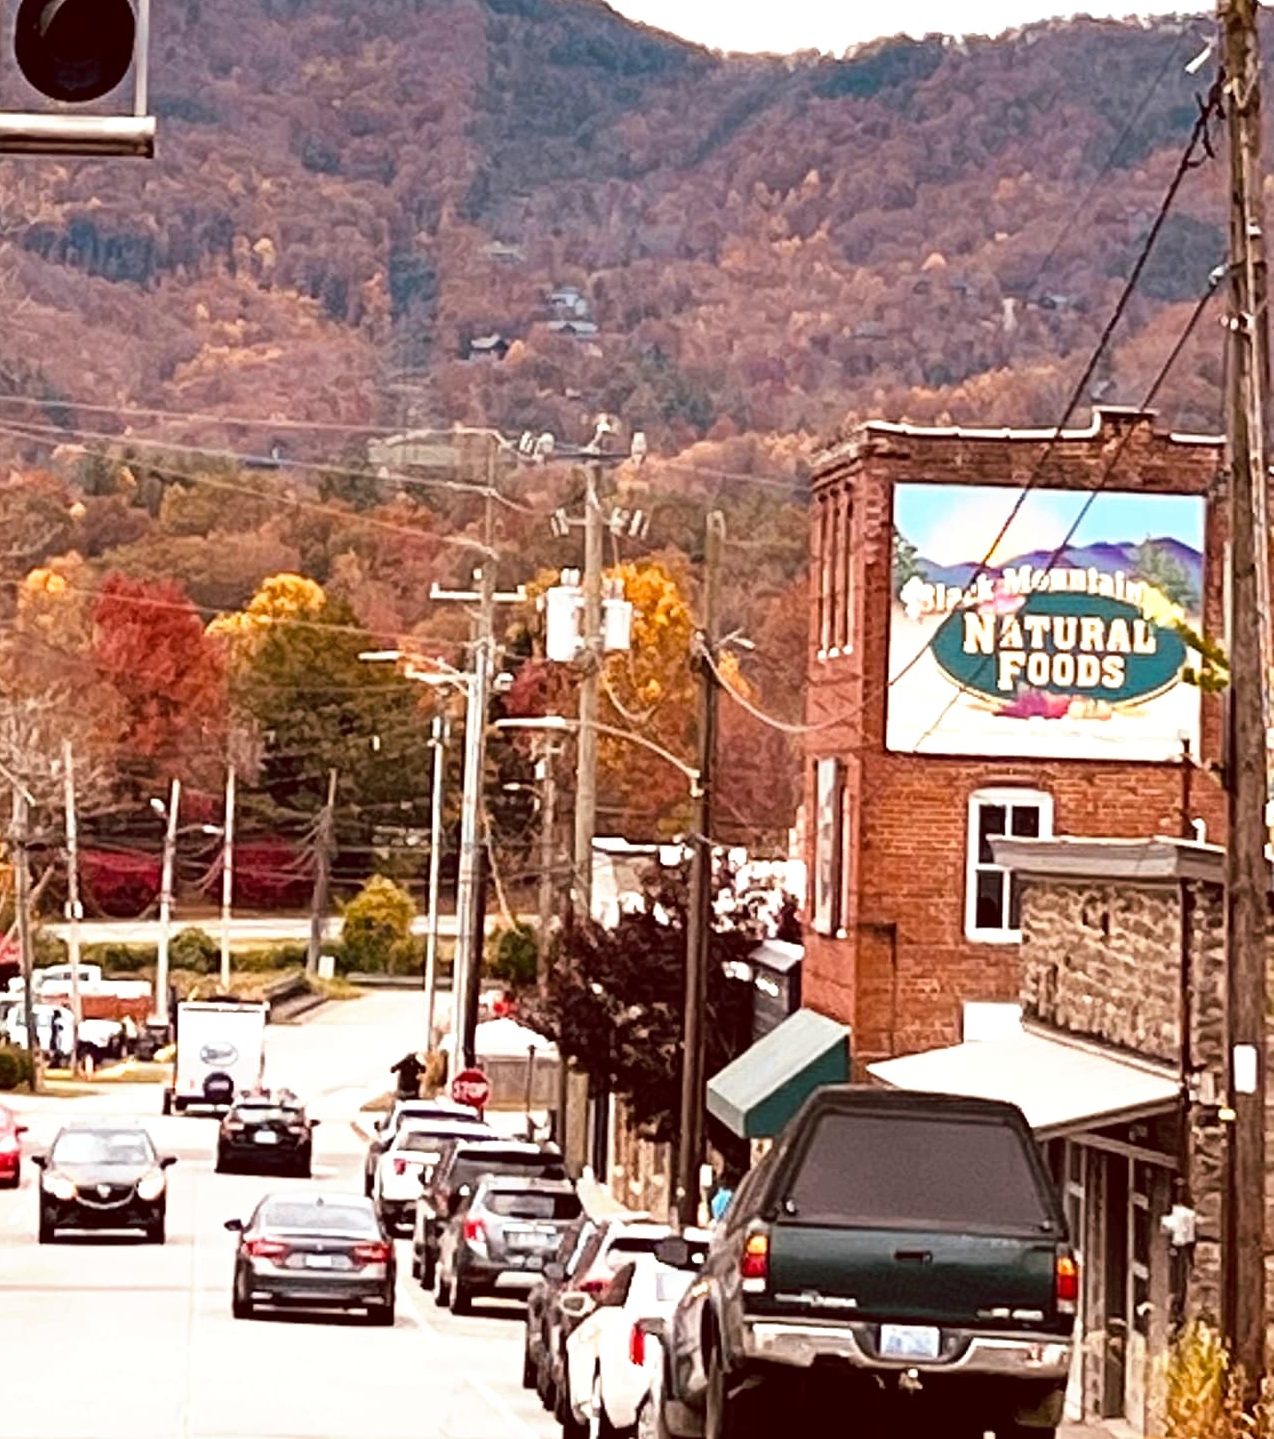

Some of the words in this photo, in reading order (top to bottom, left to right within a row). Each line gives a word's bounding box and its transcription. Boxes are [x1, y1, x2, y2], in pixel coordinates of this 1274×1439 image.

[1002, 564, 1147, 603] Mountain
[962, 613, 1157, 654] NATURAL
[996, 651, 1125, 691] FOODS
